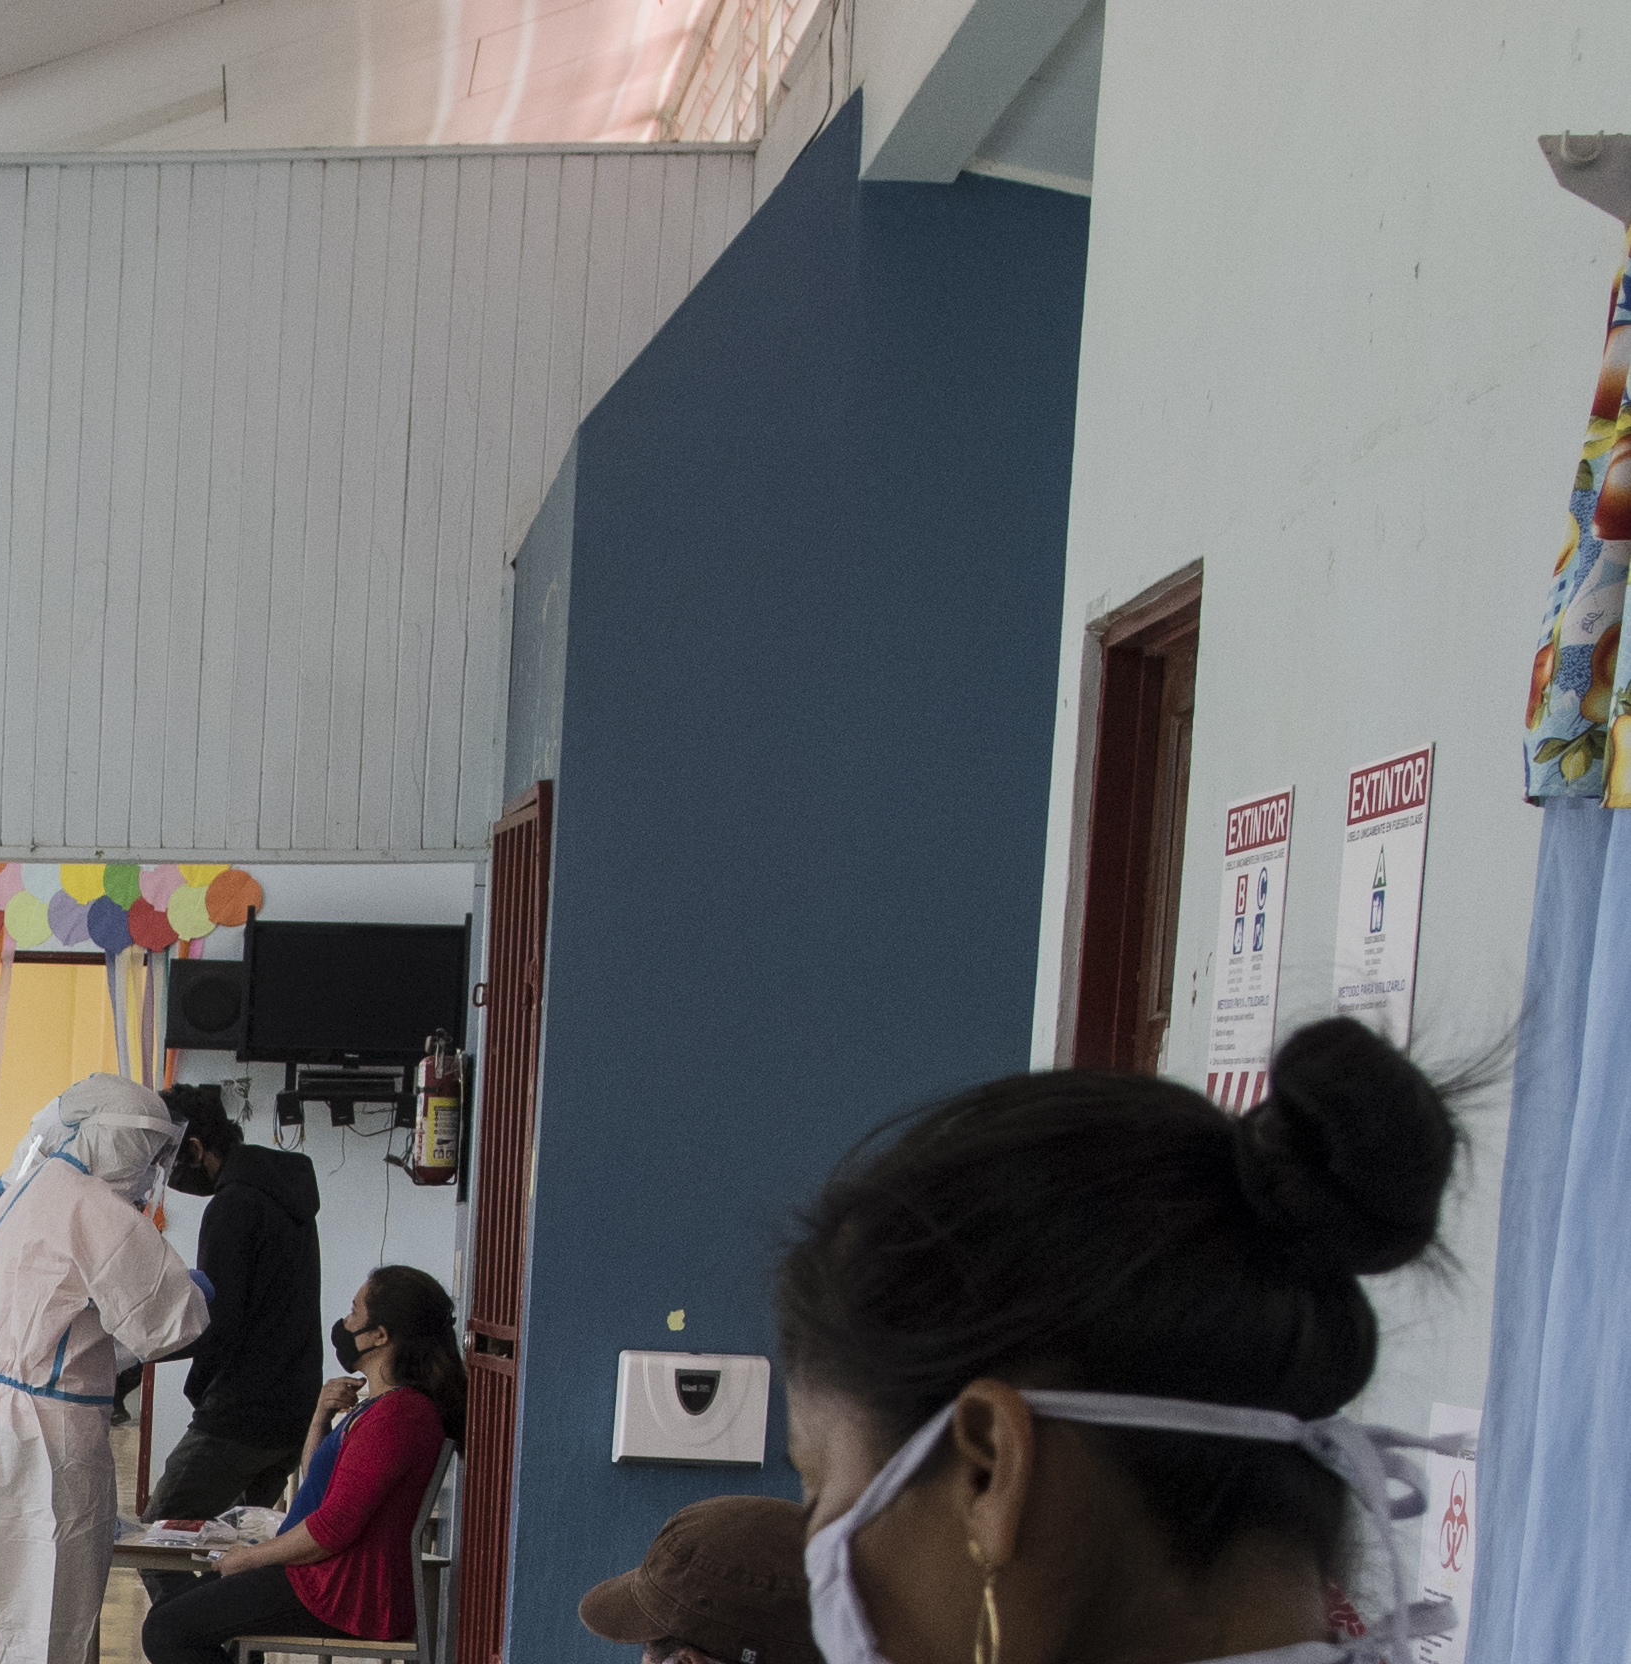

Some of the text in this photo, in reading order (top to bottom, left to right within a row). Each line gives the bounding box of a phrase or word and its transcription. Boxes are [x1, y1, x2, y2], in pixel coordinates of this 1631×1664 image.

[1350, 757, 1425, 819] EXTINTOR
[1228, 798, 1287, 850] EXTINTOR
[1238, 876, 1246, 913] B
